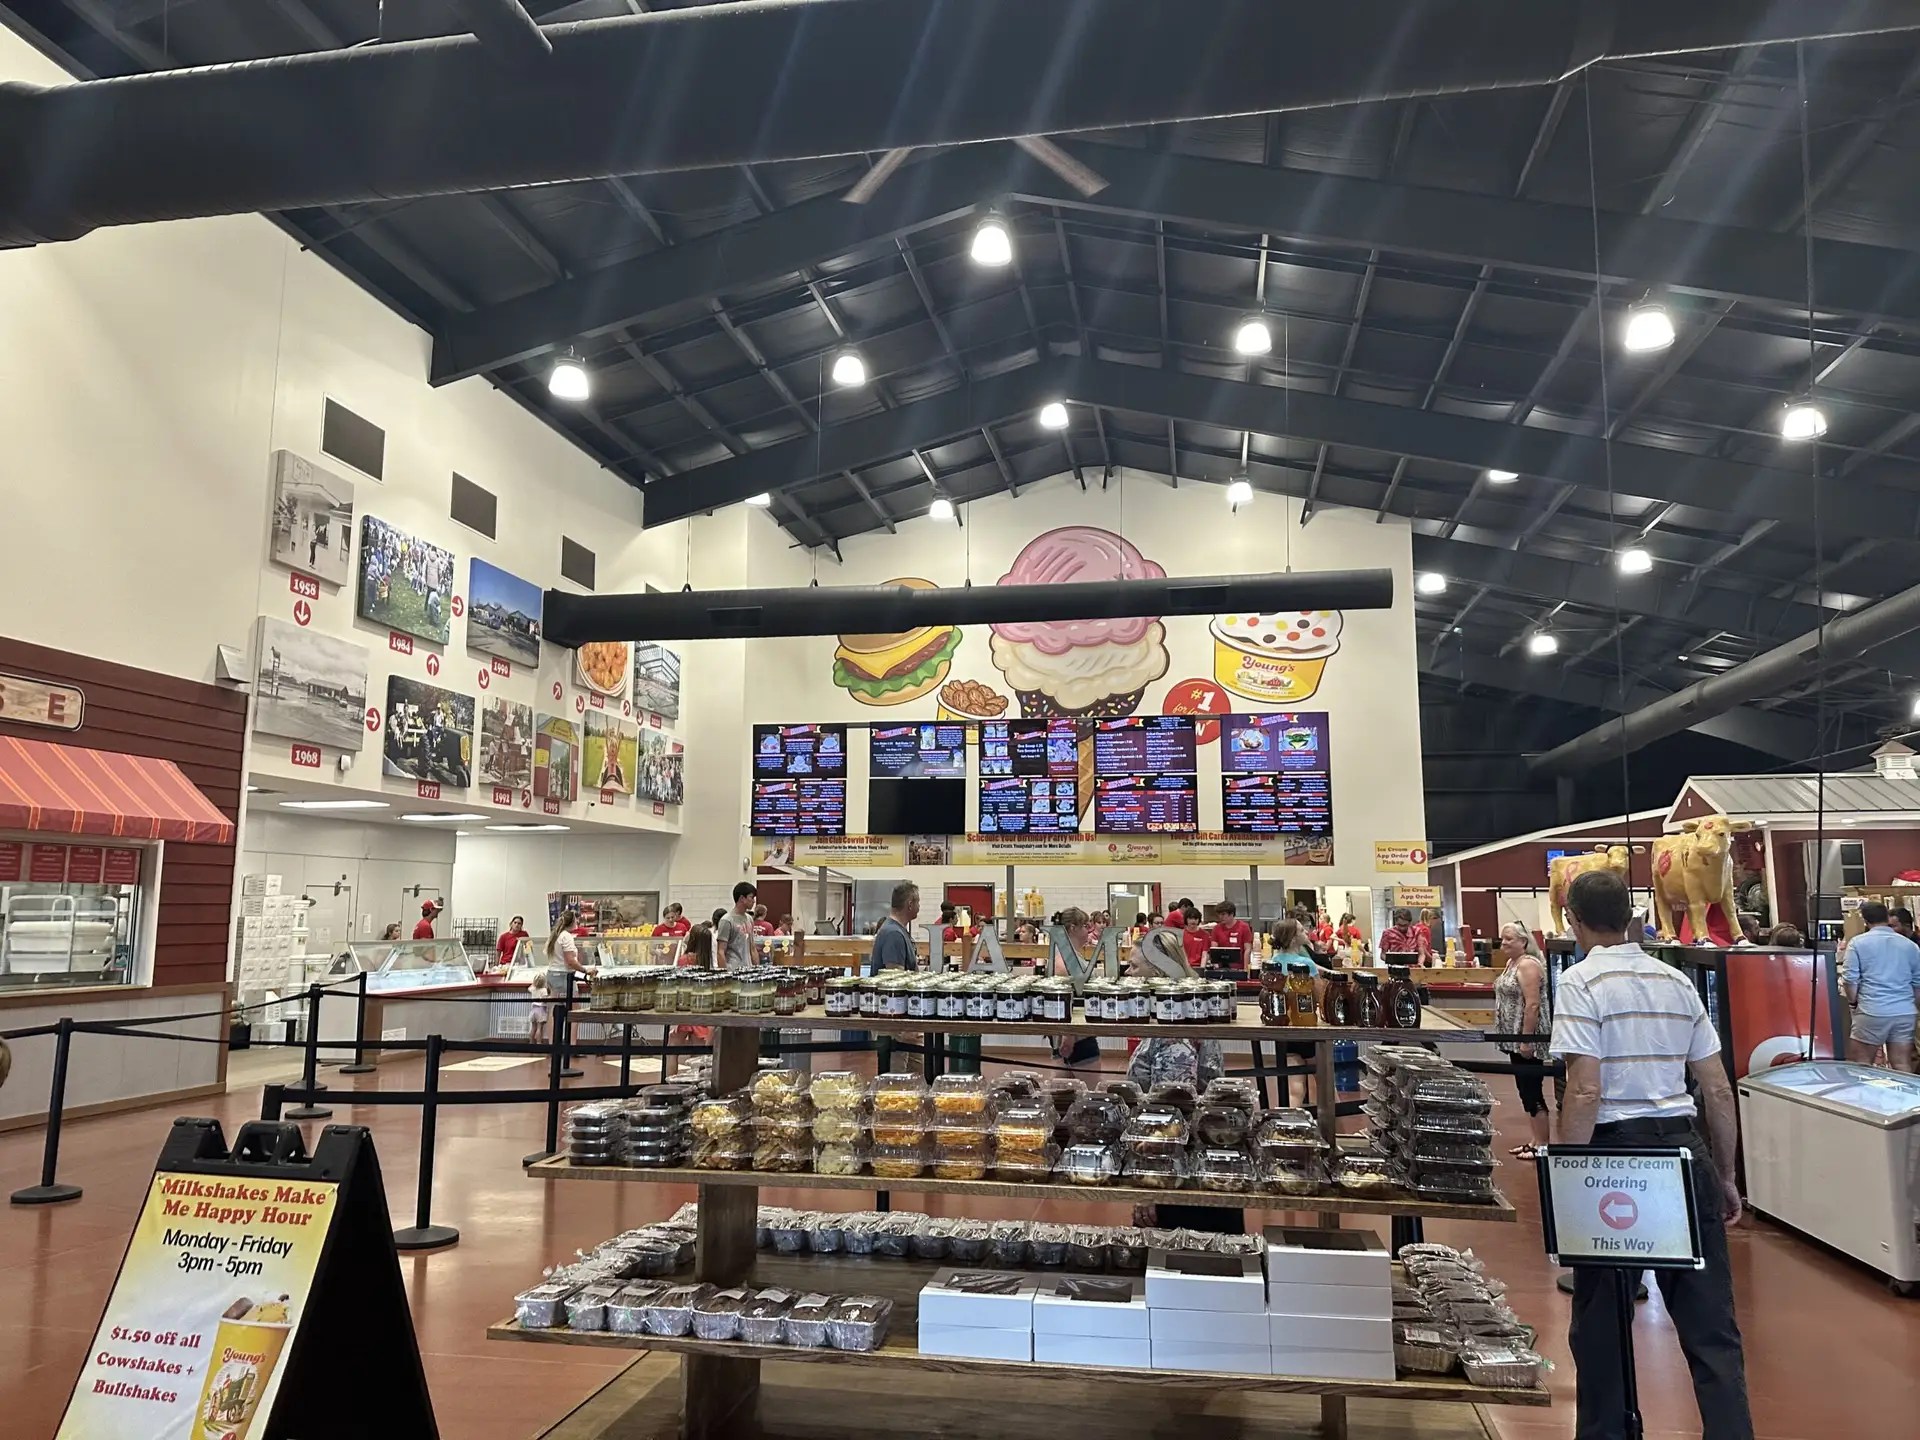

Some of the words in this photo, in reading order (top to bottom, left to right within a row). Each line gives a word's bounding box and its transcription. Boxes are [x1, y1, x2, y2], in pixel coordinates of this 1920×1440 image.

[293, 577, 317, 597] 1958
[391, 638, 411, 653] 1984
[493, 661, 508, 675] 1990
[1242, 655, 1295, 674] Young's
[1190, 688, 1216, 712] #1
[294, 749, 318, 765] 1968
[420, 783, 439, 798] 1977
[865, 836, 883, 844] Today
[1553, 1156, 1588, 1170] Food
[1591, 1157, 1603, 1170] &
[1605, 1157, 1625, 1170] Ice
[1628, 1157, 1674, 1170] Cream
[161, 1178, 269, 1202] Milkshakes
[273, 1186, 327, 1205] Make
[1584, 1175, 1648, 1191] Ordering
[162, 1199, 190, 1217] Me
[193, 1202, 257, 1225] Happy
[260, 1208, 313, 1227] Hour
[162, 1228, 229, 1254] Monday
[239, 1235, 293, 1259] Friday
[1592, 1237, 1621, 1250] This
[1624, 1238, 1655, 1254] Way
[177, 1252, 214, 1273] 3pm
[225, 1256, 263, 1278] 5pm
[110, 1326, 151, 1344] $1.50
[154, 1331, 178, 1346] off
[179, 1334, 202, 1348] all
[96, 1352, 183, 1375] Cowshakes
[222, 1347, 267, 1366] Young's
[92, 1379, 178, 1404] Bullshakes
